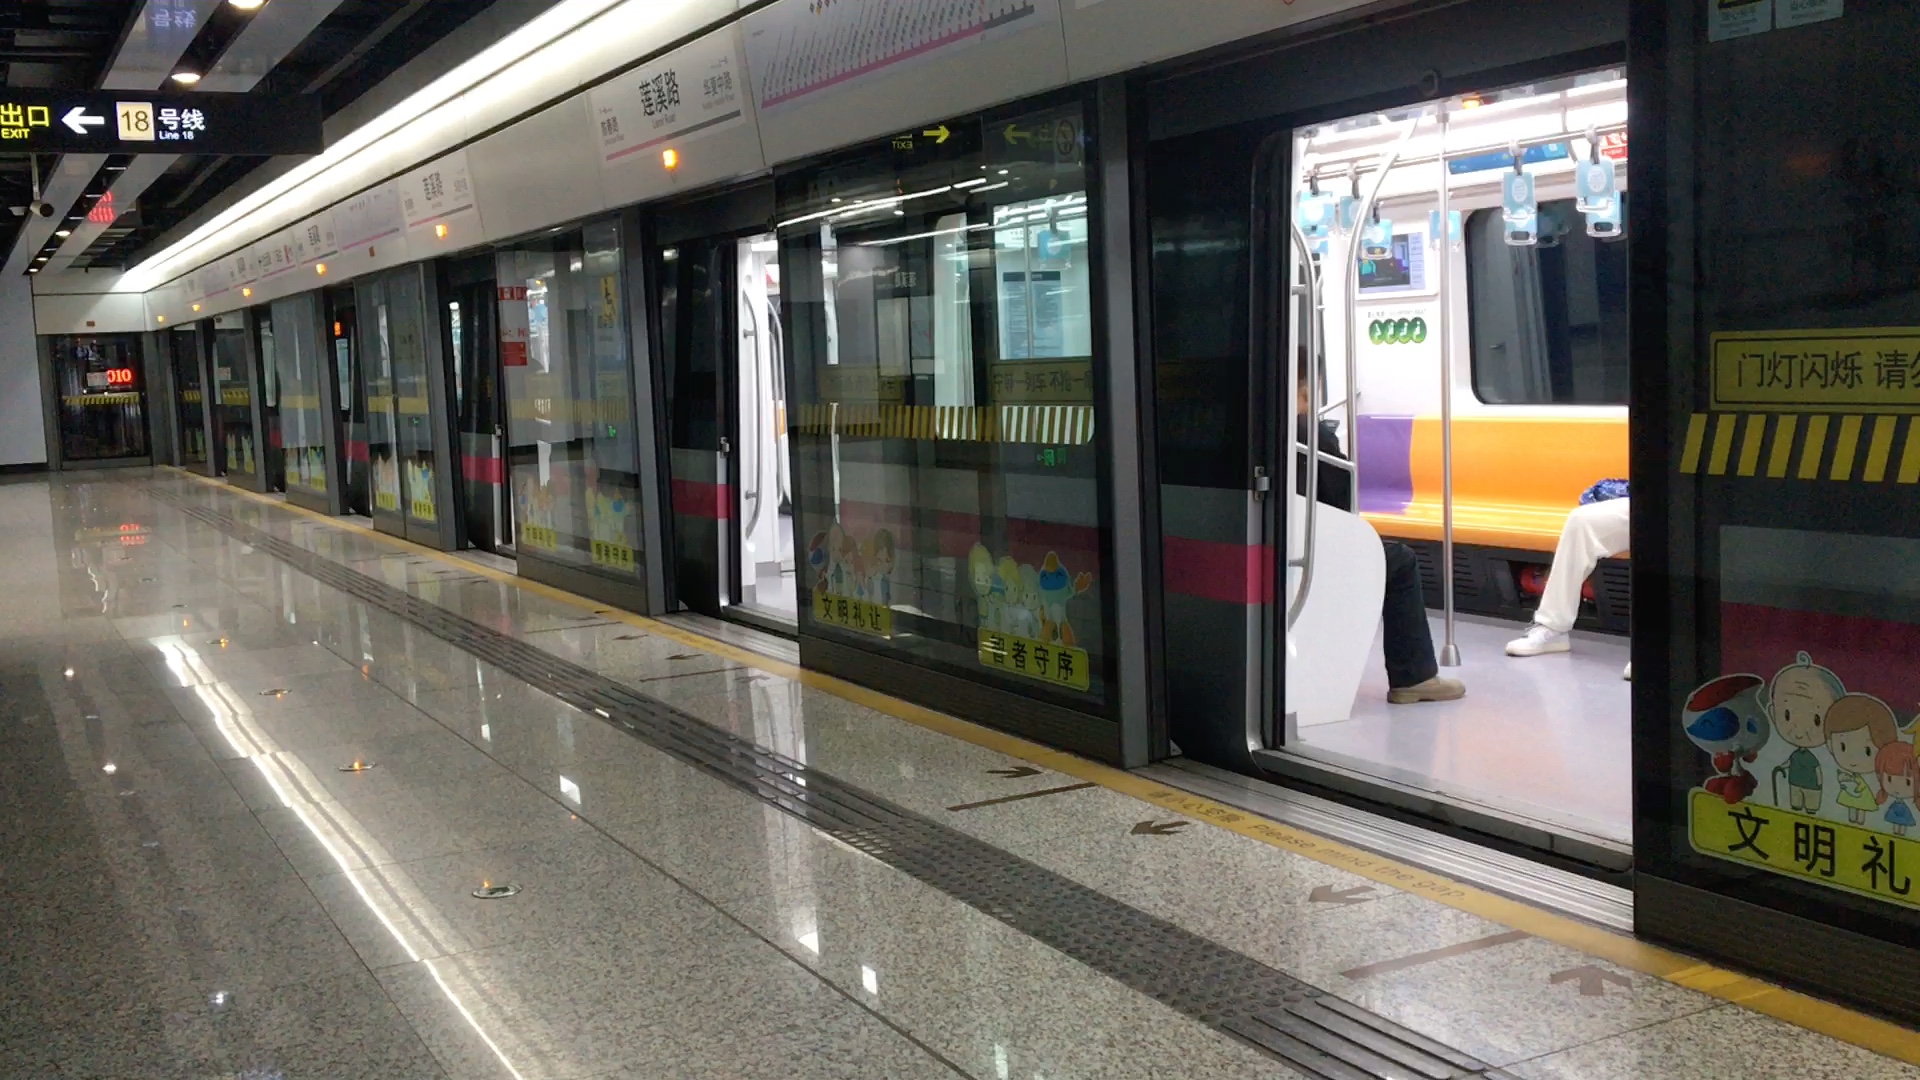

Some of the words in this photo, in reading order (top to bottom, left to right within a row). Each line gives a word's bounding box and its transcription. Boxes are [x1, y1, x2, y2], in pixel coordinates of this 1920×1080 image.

[638, 67, 681, 117] 莲溪路
[0, 102, 50, 127] 出口
[1, 128, 30, 139] EXIT
[120, 110, 150, 132] 18
[158, 108, 205, 131] 号线
[159, 131, 179, 140] Line
[182, 131, 194, 140] 18
[1737, 350, 1864, 390] 门灯闪烁
[822, 593, 882, 632] 文明礼让
[1247, 823, 1316, 849] Please
[1317, 847, 1373, 868] mind
[1375, 865, 1415, 881] the
[1727, 806, 1911, 895] 文明礼
